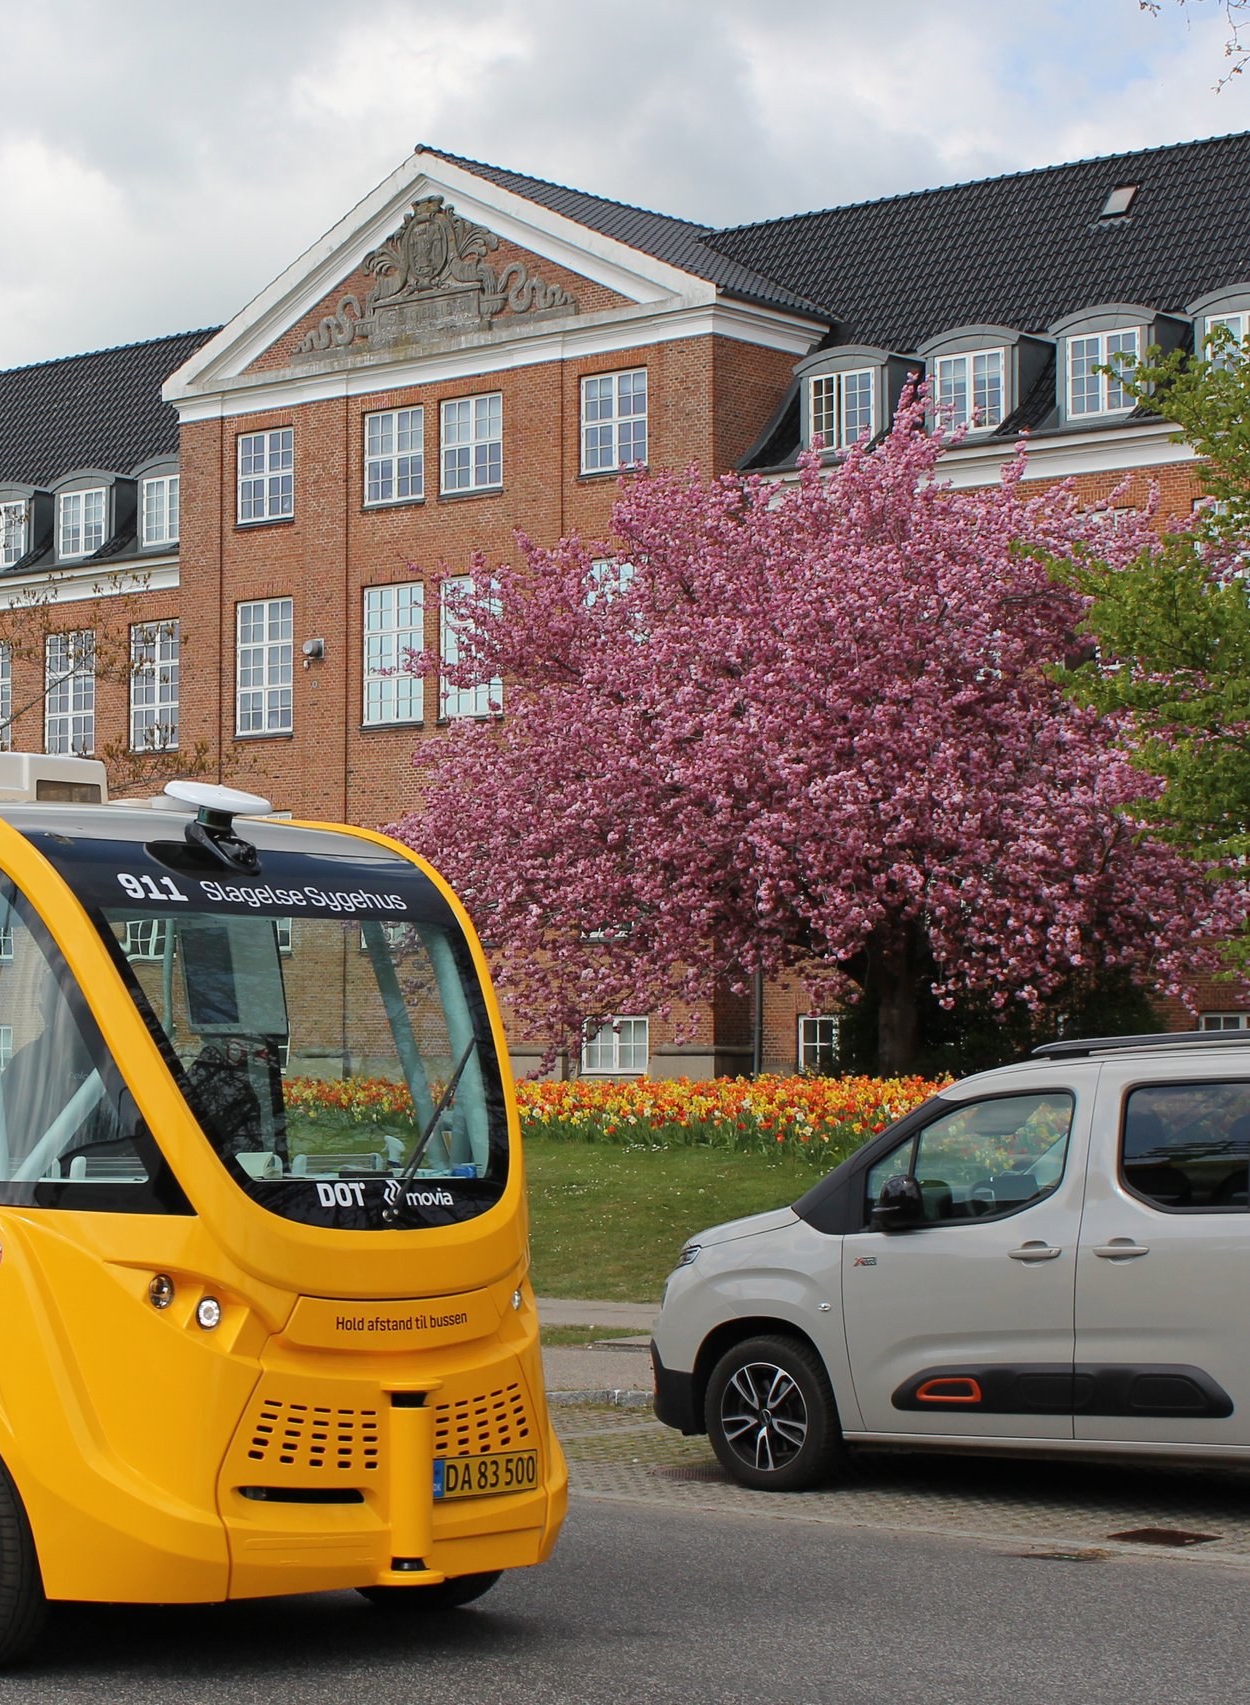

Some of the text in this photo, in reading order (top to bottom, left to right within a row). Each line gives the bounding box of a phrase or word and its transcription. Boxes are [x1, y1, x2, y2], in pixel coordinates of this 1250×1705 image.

[116, 872, 189, 902] 911
[199, 880, 408, 912] Slagelse Sygehus
[315, 1182, 366, 1207] DOT
[406, 1188, 454, 1206] movia
[335, 1312, 468, 1331] Hold afstand til bussen
[445, 1455, 536, 1492] DA 83 500
